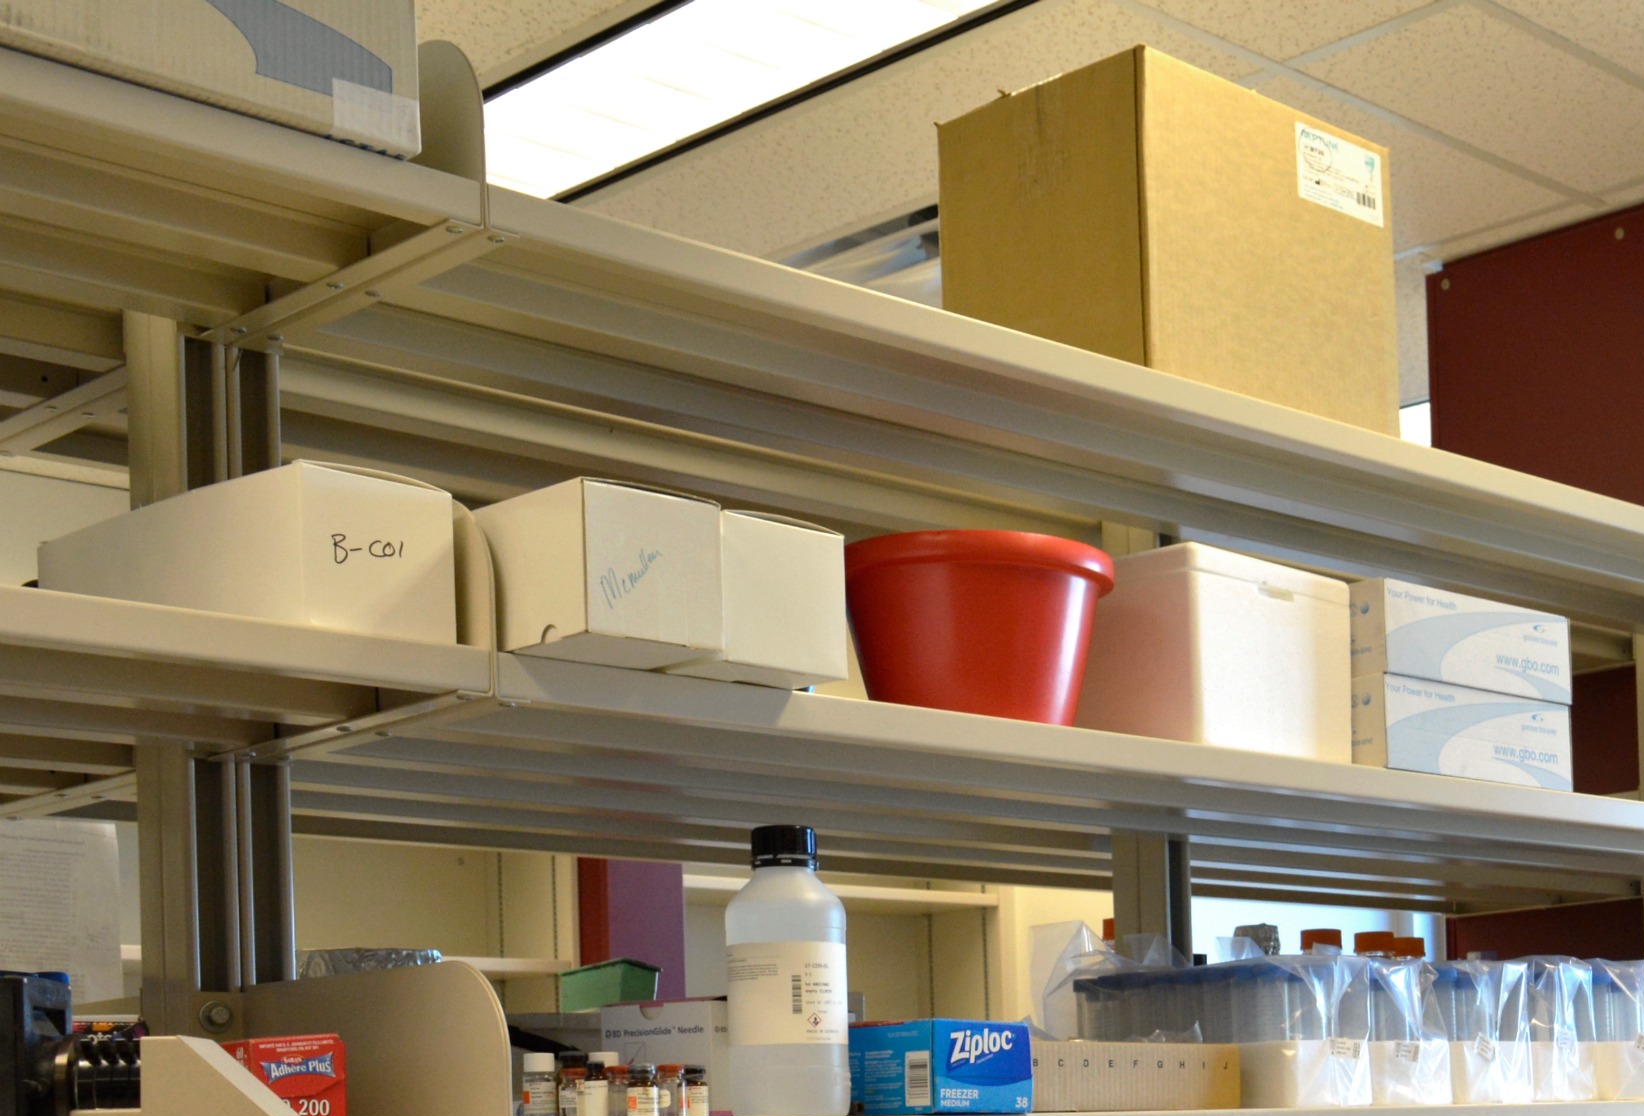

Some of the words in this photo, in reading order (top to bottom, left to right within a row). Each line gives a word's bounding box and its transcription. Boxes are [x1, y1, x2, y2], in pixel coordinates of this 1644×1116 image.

[1387, 586, 1404, 598] Your
[1404, 591, 1426, 603] Power
[1426, 596, 1436, 606] for
[1437, 598, 1457, 610] Health
[1496, 654, 1560, 675] www.gbo.com
[1386, 682, 1401, 693] Your
[1402, 685, 1422, 697] Power
[1423, 689, 1433, 699] for
[1435, 691, 1456, 703] Health
[1493, 744, 1558, 765] www.gbo.com
[677, 1025, 704, 1034] Needle
[950, 1028, 1013, 1064] Ziploc
[270, 1062, 307, 1079] Adhère
[308, 1058, 332, 1073] Plus
[1033, 1059, 1039, 1067] B
[1058, 1059, 1064, 1067] C
[1084, 1059, 1089, 1067] D
[1109, 1060, 1114, 1068] E
[1133, 1060, 1139, 1068] F
[1157, 1060, 1163, 1068] G
[1180, 1061, 1185, 1069] H
[1202, 1061, 1205, 1069] I
[1223, 1062, 1228, 1070] J
[940, 1088, 979, 1099] FREEZER
[940, 1099, 970, 1107] MEDIUM
[1015, 1097, 1028, 1108] 38
[298, 1099, 330, 1116] 200
